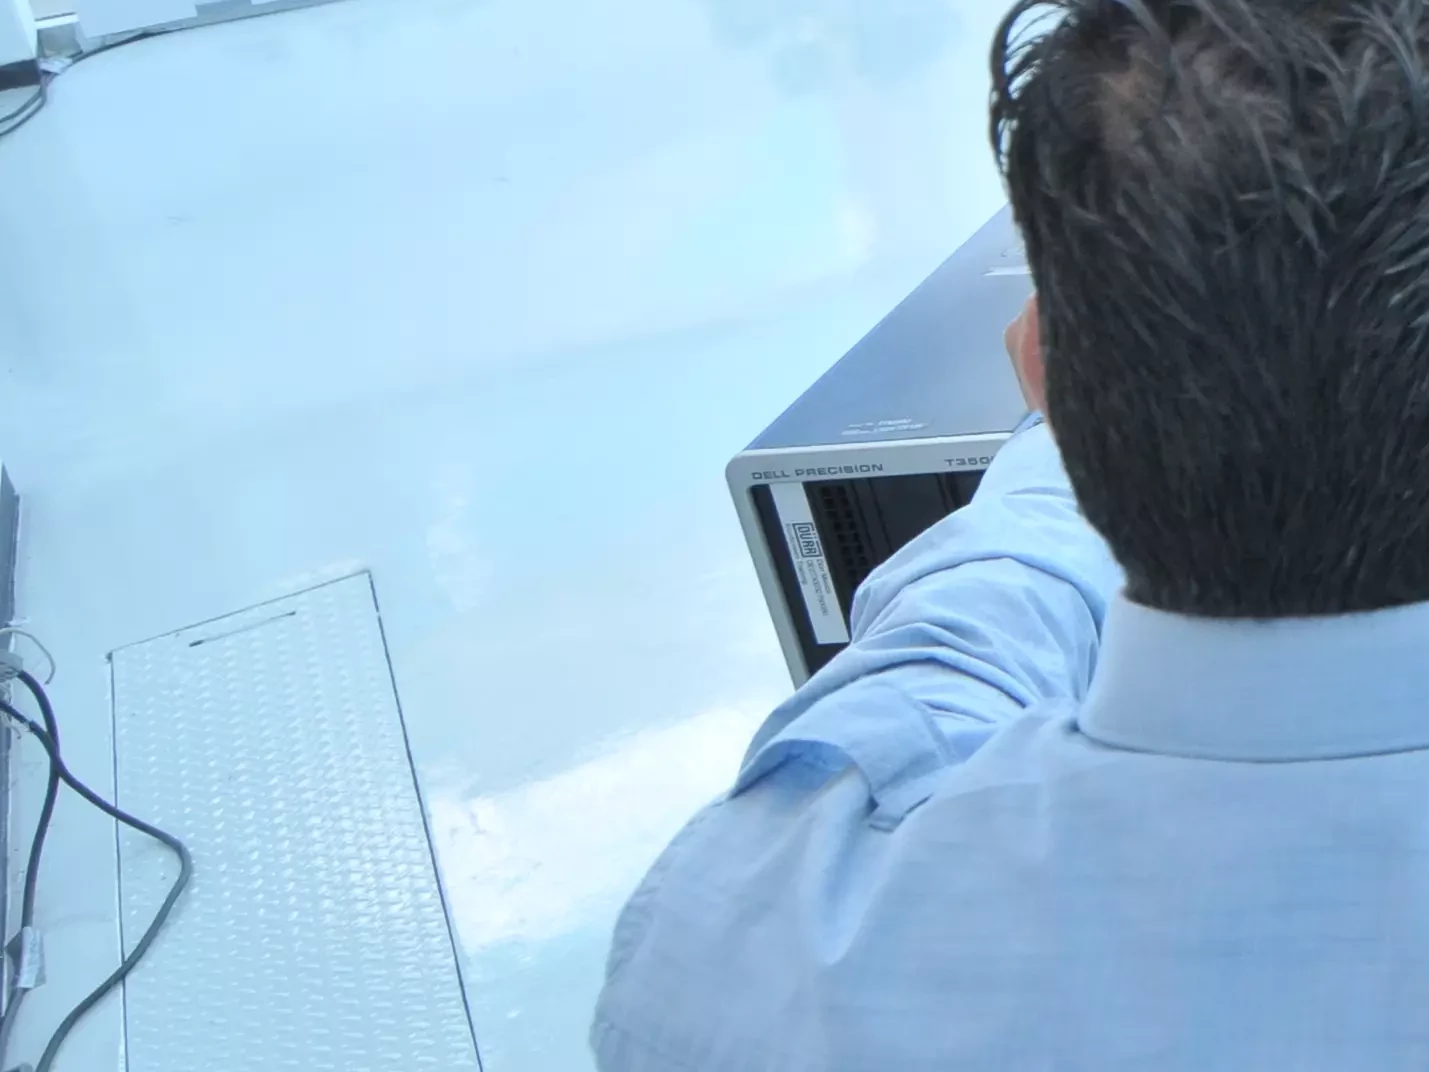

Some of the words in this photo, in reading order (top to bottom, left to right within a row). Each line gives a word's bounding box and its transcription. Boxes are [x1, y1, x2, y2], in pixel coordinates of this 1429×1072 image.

[752, 469, 790, 480] DELL
[795, 463, 884, 477] PRECISION
[944, 456, 993, 467] T350
